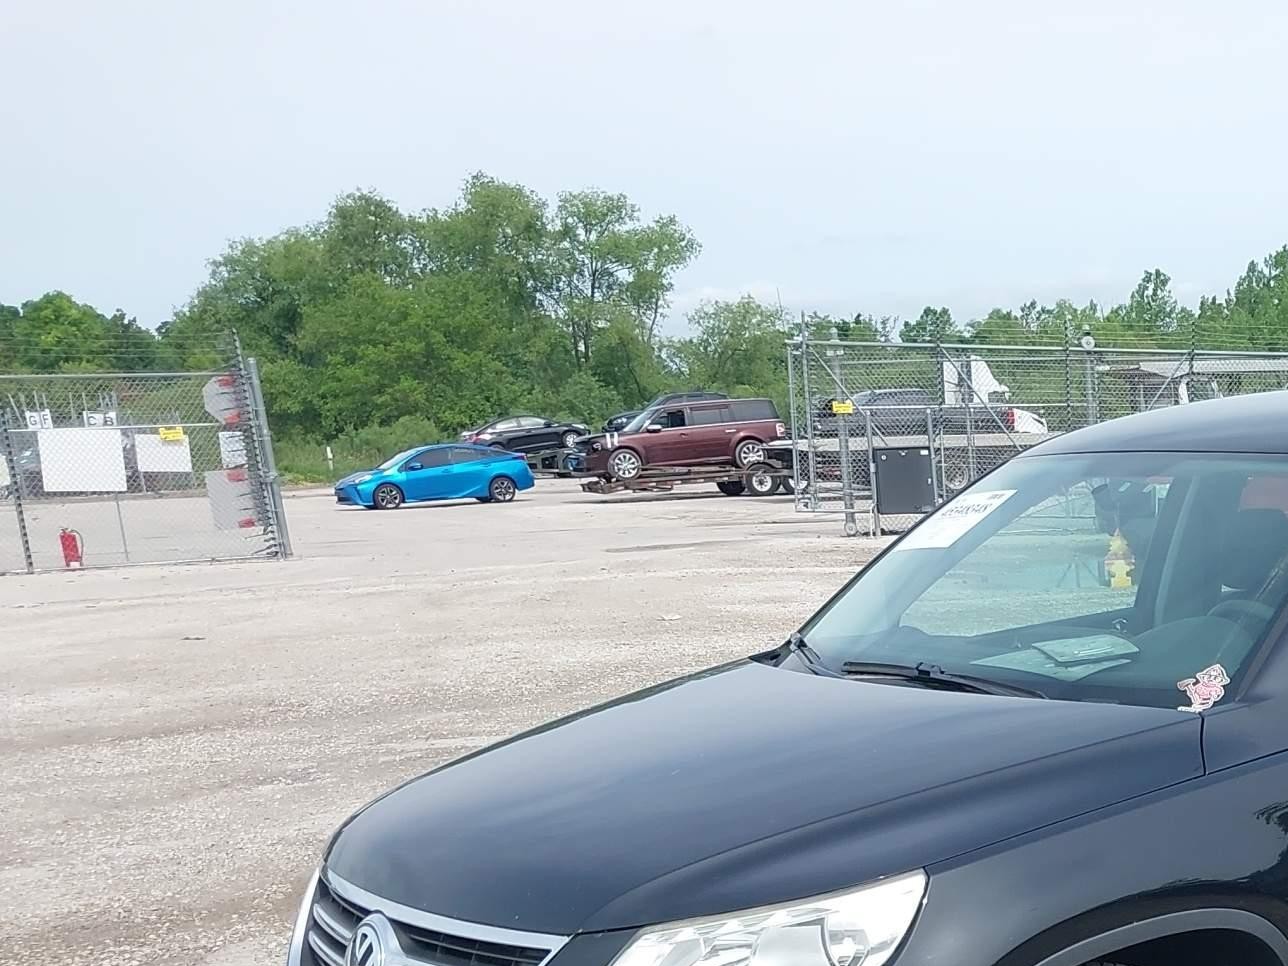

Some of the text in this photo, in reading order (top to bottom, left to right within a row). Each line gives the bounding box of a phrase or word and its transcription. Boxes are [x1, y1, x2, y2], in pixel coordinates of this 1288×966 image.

[28, 415, 37, 426] G
[42, 413, 49, 425] F
[88, 415, 97, 426] C
